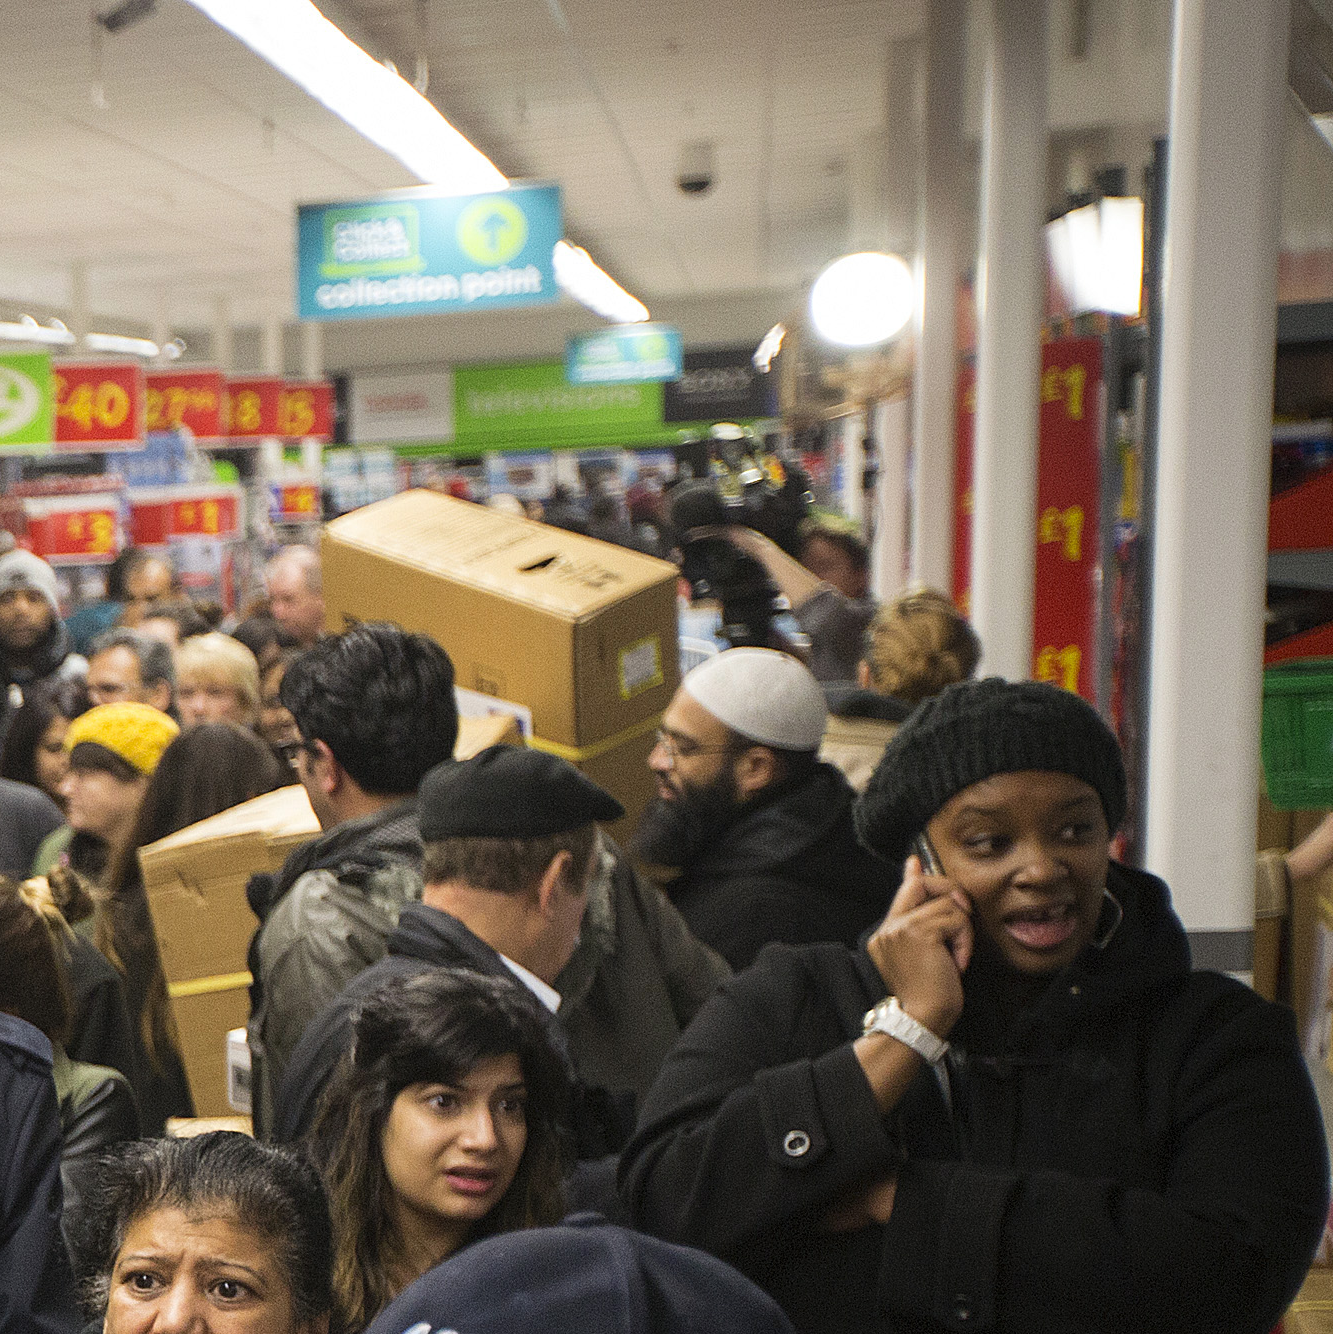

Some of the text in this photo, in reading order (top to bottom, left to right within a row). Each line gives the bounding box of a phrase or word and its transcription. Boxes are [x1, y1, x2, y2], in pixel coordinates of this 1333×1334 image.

[316, 265, 542, 310] collection point
[1041, 364, 1086, 420] £1
[1039, 505, 1084, 561] £1
[1036, 645, 1082, 692] £1
